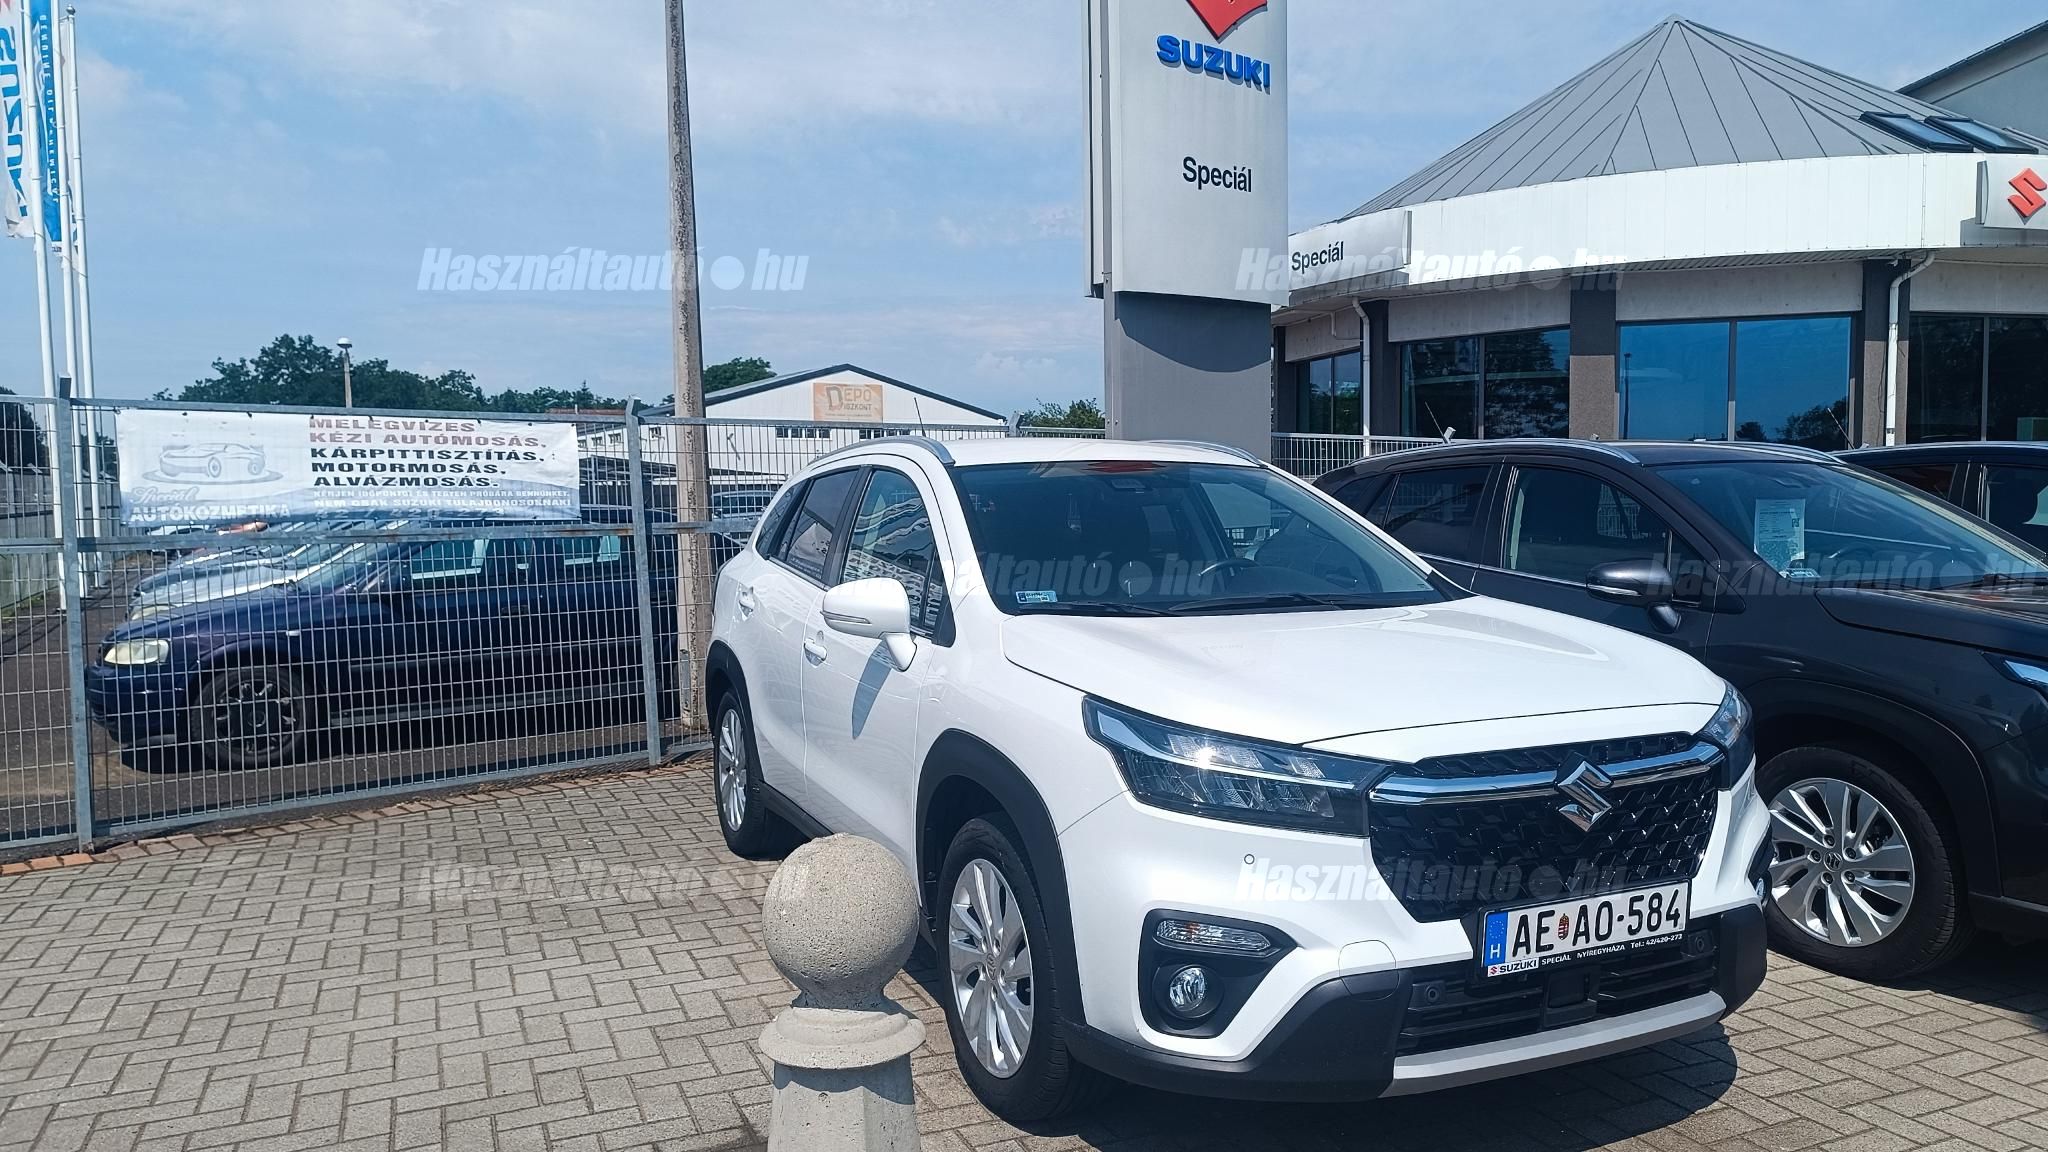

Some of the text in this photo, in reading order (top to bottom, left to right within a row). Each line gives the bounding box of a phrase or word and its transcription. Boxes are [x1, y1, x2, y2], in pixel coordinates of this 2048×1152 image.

[1156, 35, 1270, 91] SUZUKI
[1182, 156, 1252, 192] Speciál
[1291, 241, 1344, 273] Speciál
[309, 419, 475, 431] MELEGVIZES
[310, 431, 546, 447] KÉZI AUTÓMOSÁS.
[310, 446, 544, 462] KÁRPITTISZTÍTÁS.
[311, 462, 506, 474] MOTORMOSÁS.
[314, 475, 498, 486] ALVÁZMOSÁS.
[1512, 910, 1556, 957] AE
[1490, 944, 1501, 959] H
[1500, 959, 1538, 973] SUZUKI
[1541, 954, 1571, 966] SPECIÁL
[1576, 944, 1626, 959] NYÍREGYHÁZA
